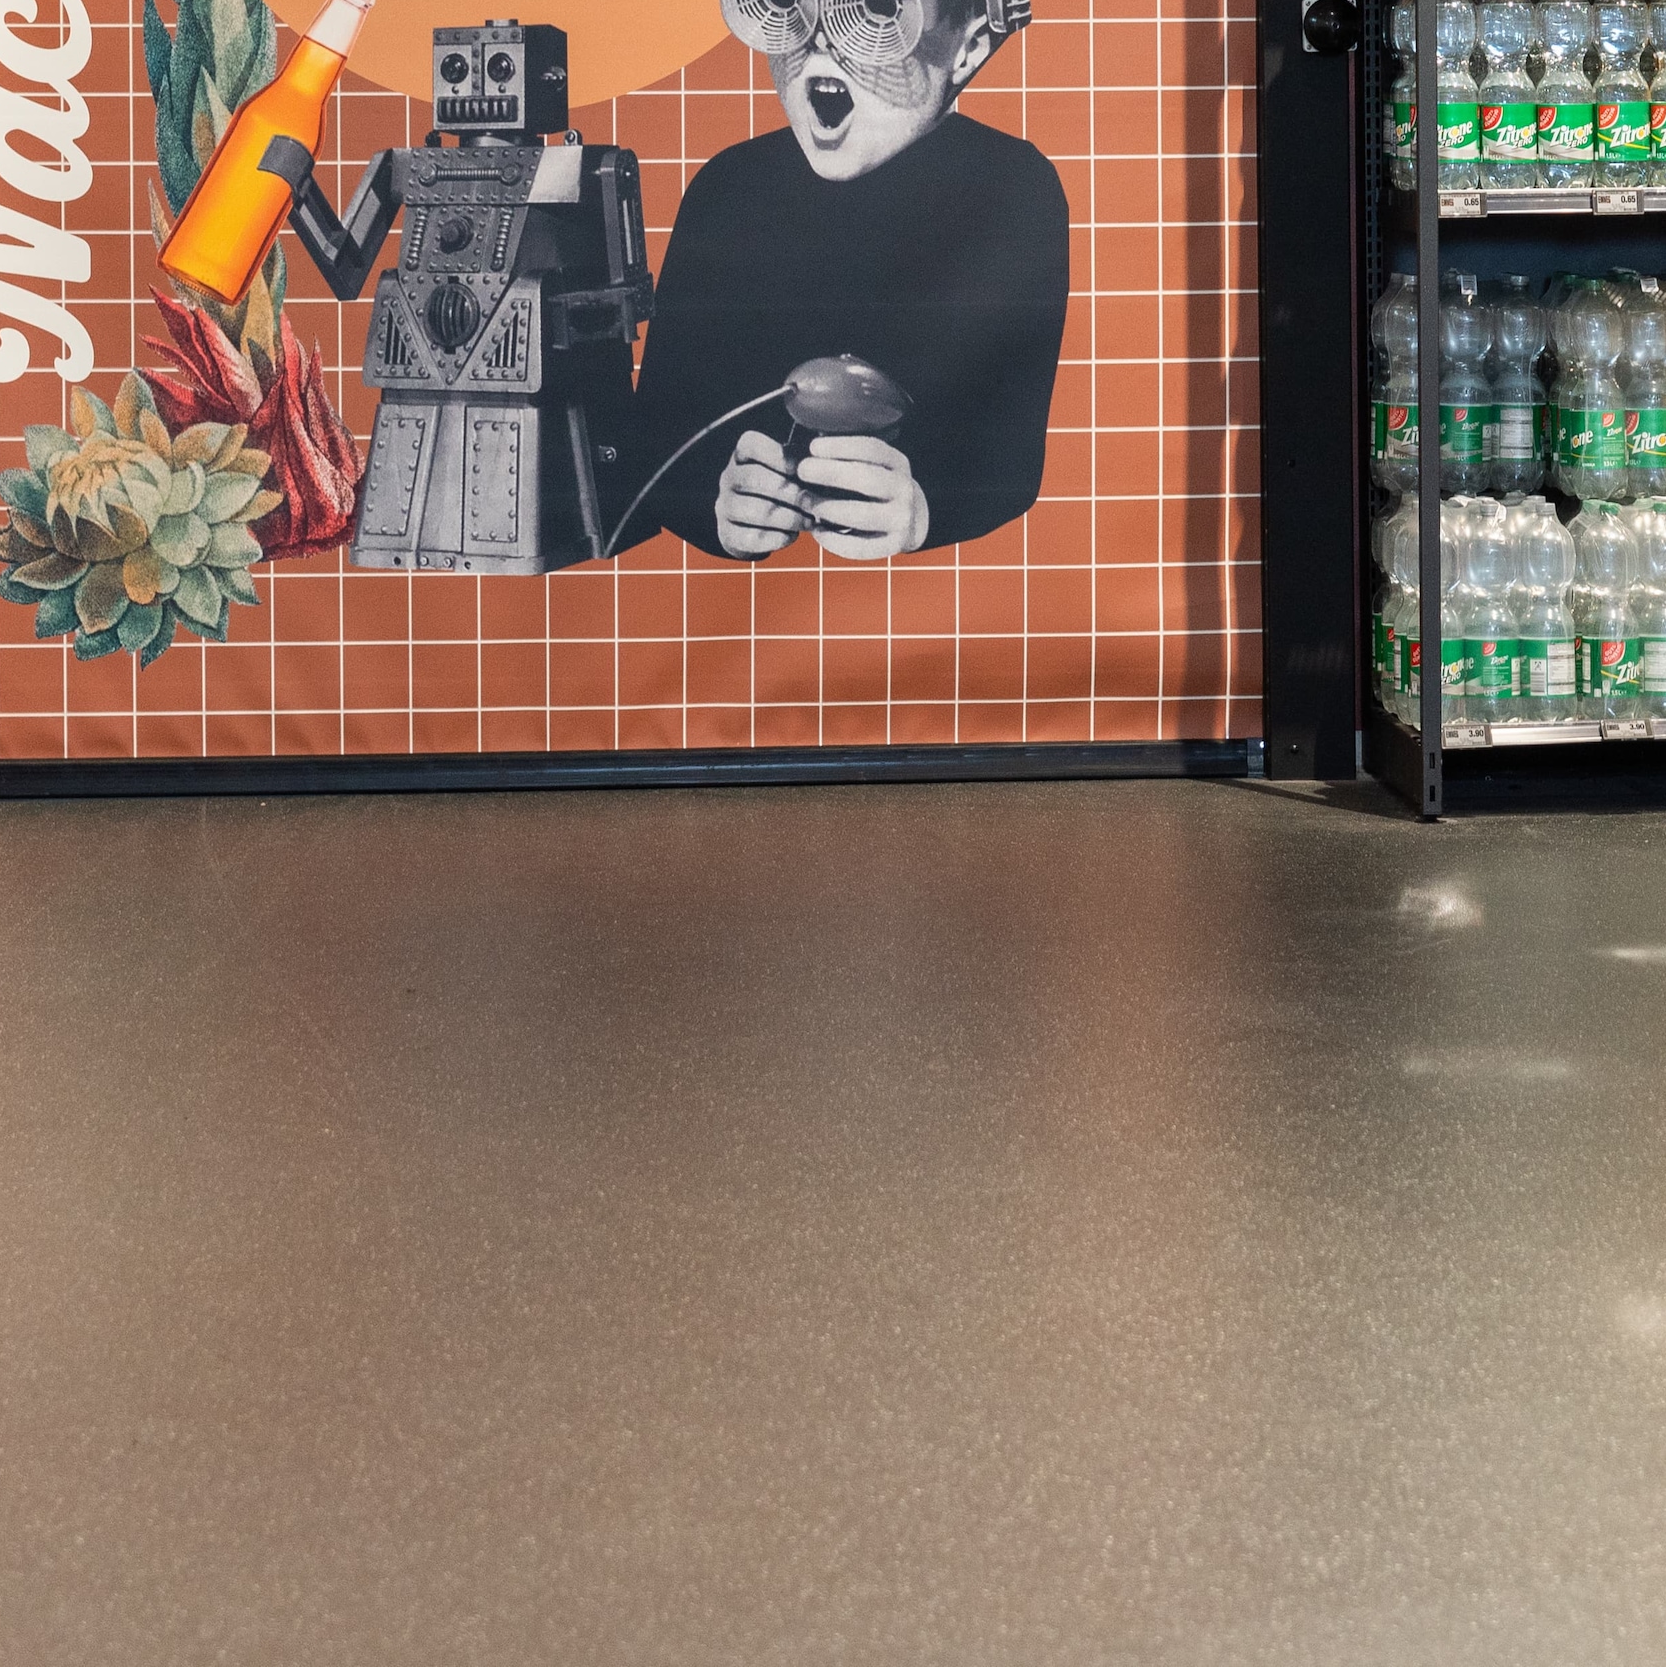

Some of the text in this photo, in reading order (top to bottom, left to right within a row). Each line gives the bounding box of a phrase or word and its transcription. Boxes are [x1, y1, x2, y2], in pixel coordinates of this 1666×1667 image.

[1440, 135, 1463, 149] ZERO
[1565, 135, 1588, 150] ZERO
[1464, 198, 1479, 206] 0.65
[1620, 195, 1636, 204] 0.65
[1629, 723, 1645, 731] 3.90
[1468, 729, 1484, 738] 3.90
